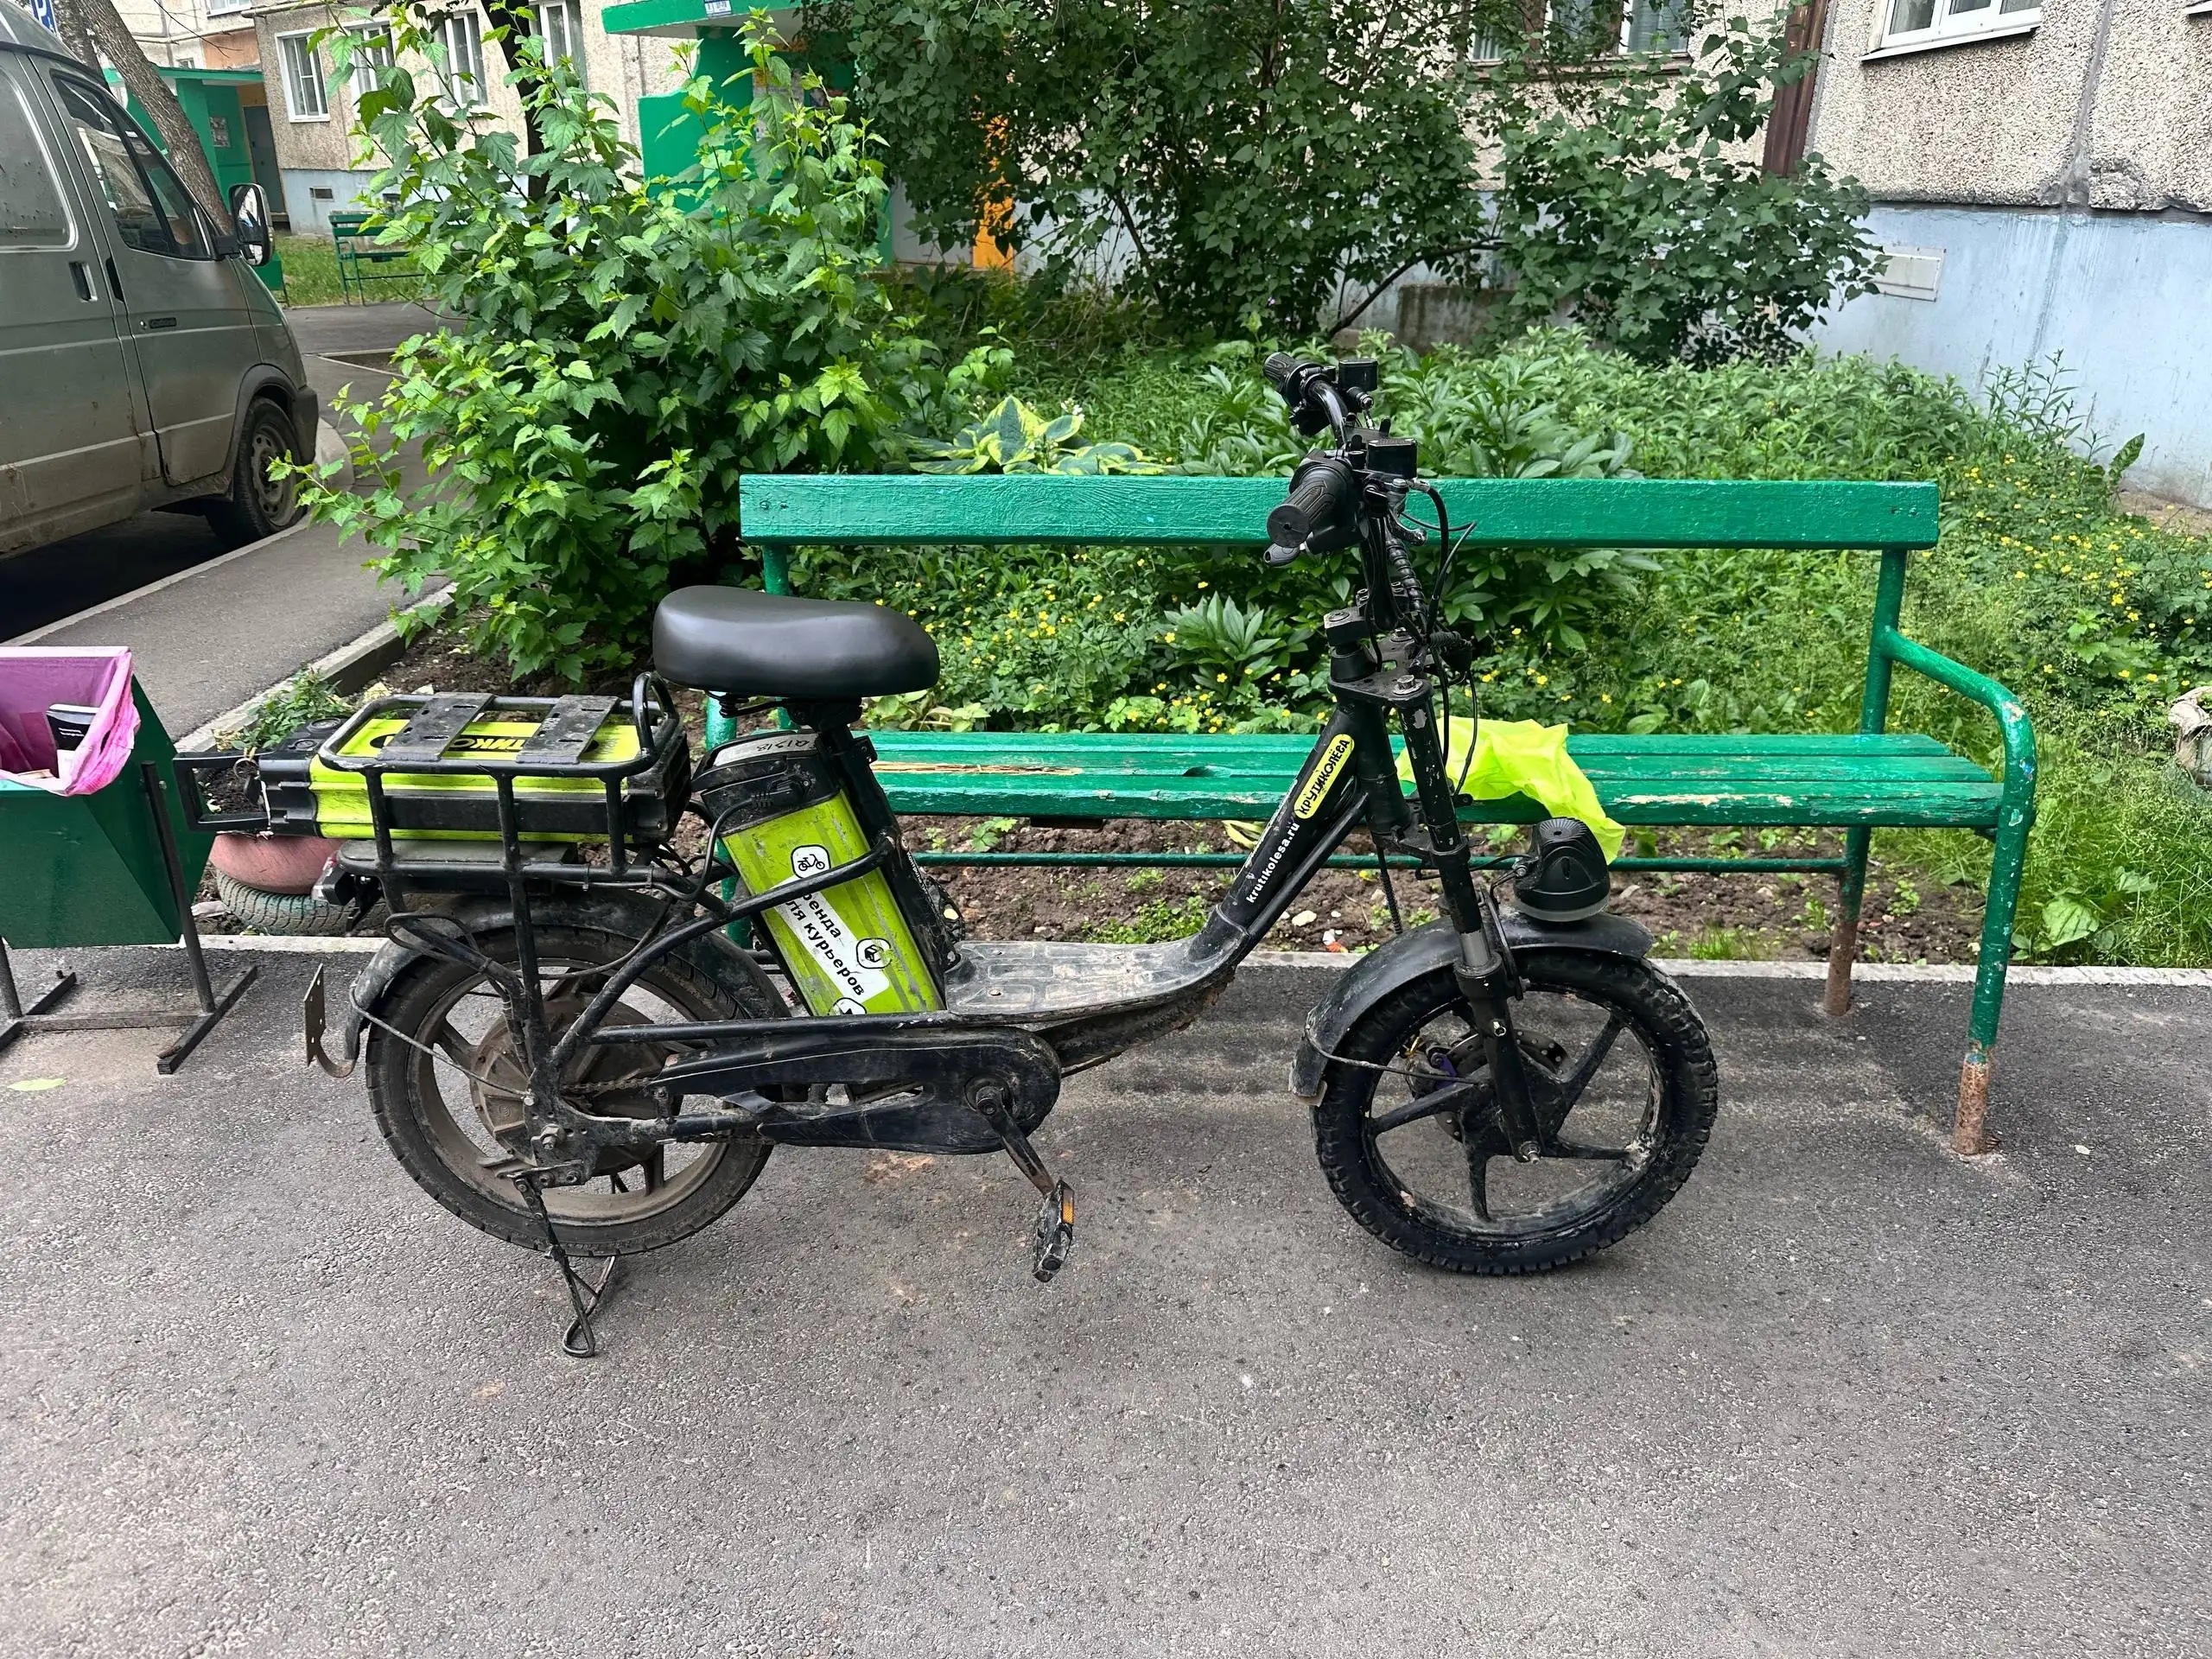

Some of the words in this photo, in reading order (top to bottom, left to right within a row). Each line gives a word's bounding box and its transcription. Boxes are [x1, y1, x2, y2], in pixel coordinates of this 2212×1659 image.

[1299, 739, 1351, 816] КРУТИКОЛЁСА
[1245, 822, 1300, 904] krutikolesa.ru
[785, 900, 807, 921] ля
[799, 922, 865, 996] курьеров
[803, 893, 842, 938] ренда
